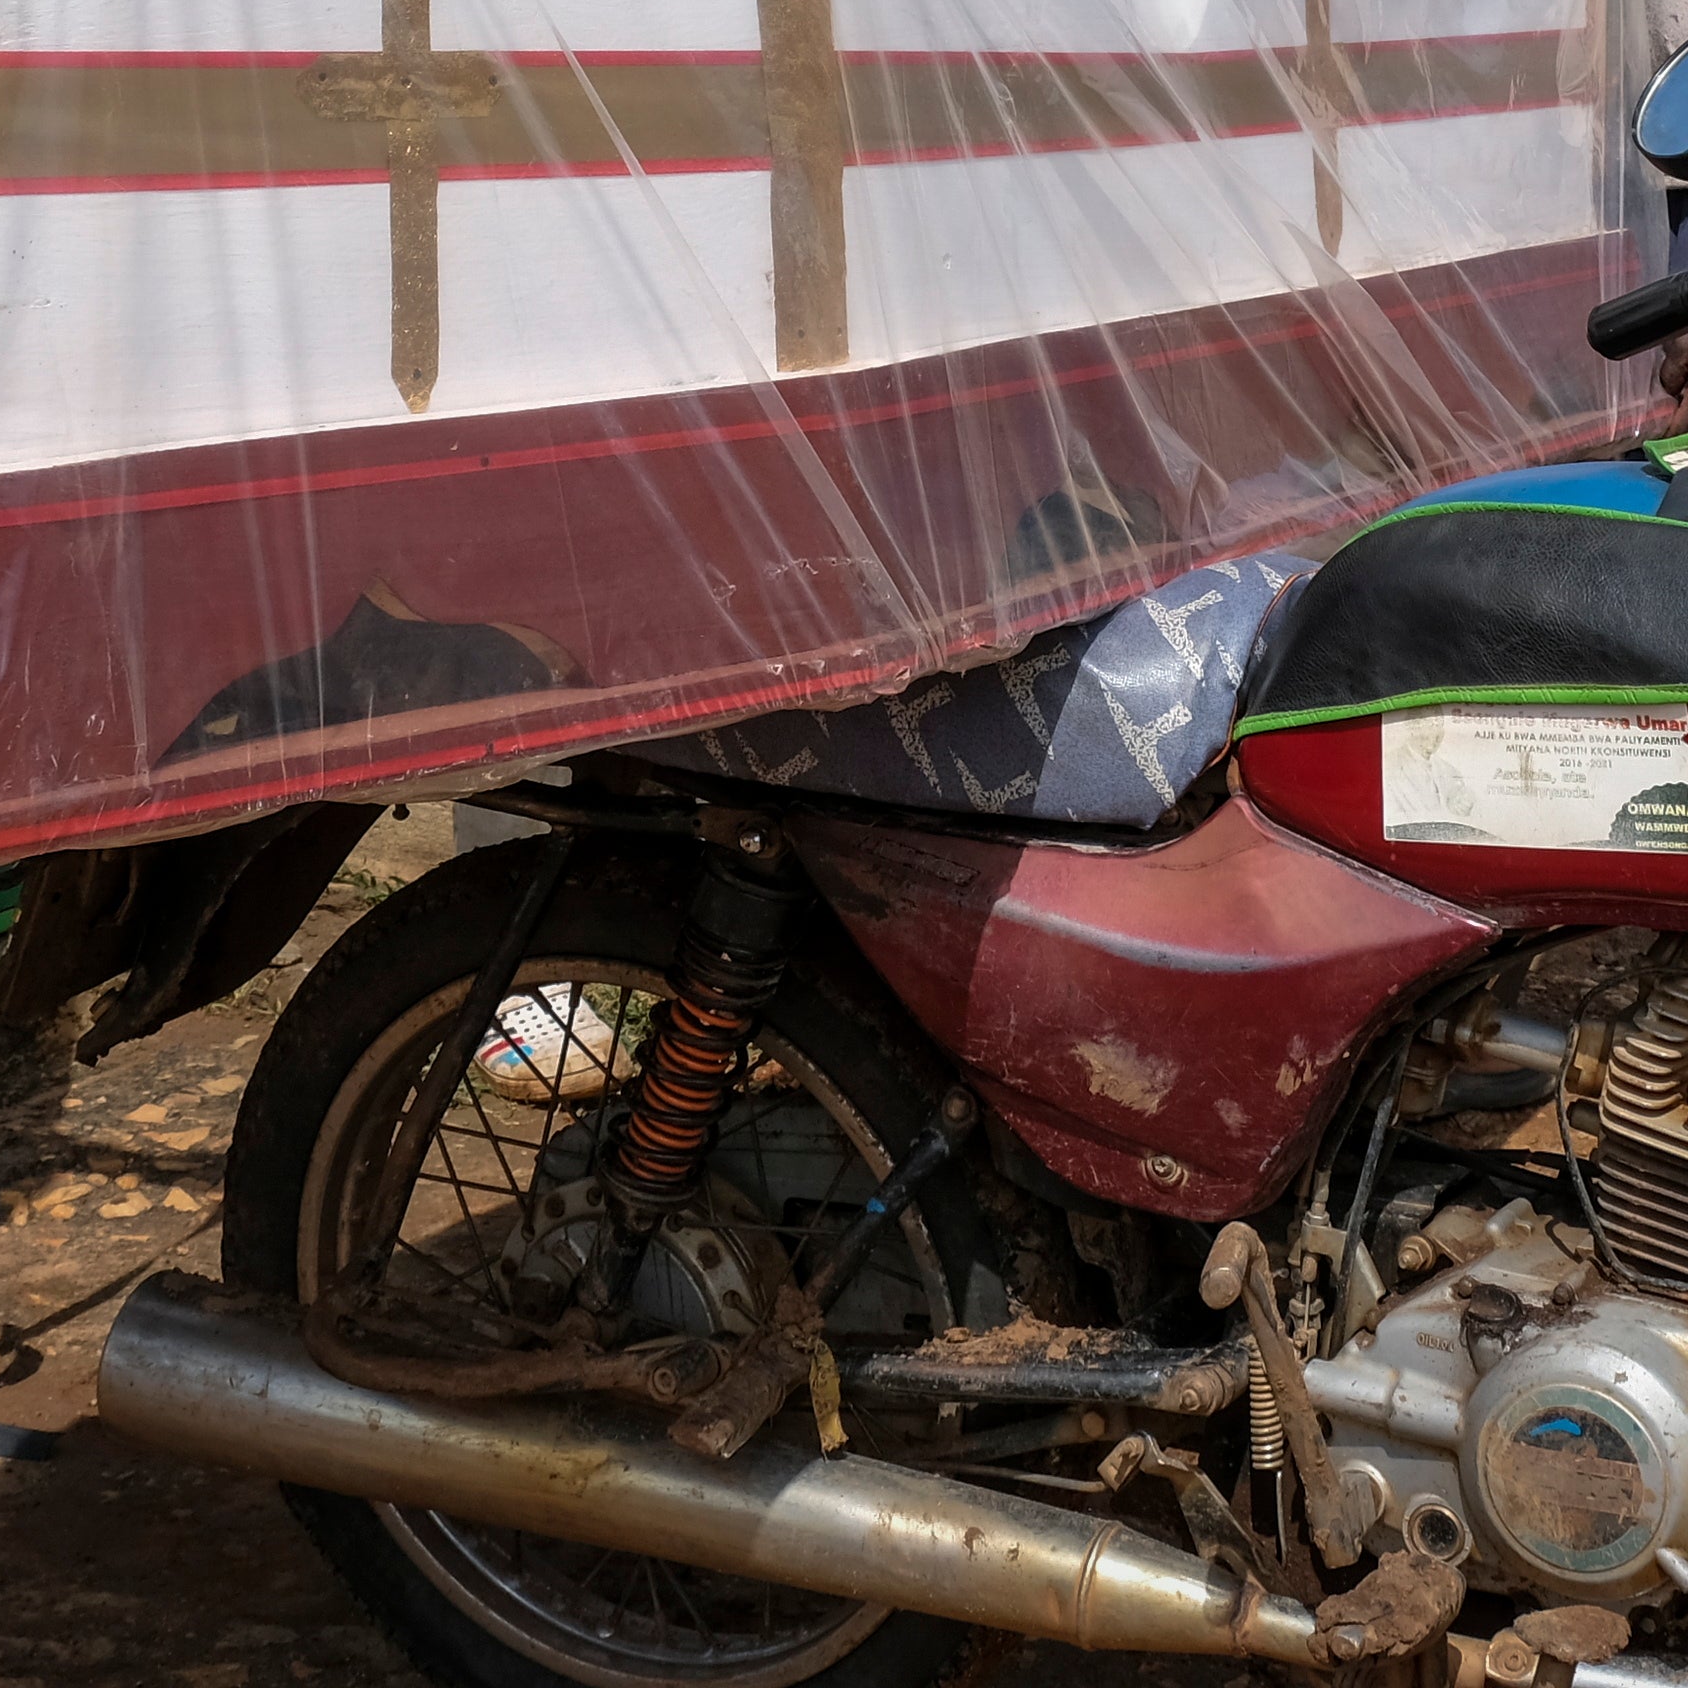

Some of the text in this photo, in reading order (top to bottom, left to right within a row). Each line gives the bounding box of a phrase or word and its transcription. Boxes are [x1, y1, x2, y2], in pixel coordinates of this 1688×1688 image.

[1636, 715, 1688, 732] Umar
[1514, 732, 1536, 742] BWA
[1589, 735, 1612, 744] BWA
[1615, 735, 1681, 746] PALIYAMENTI
